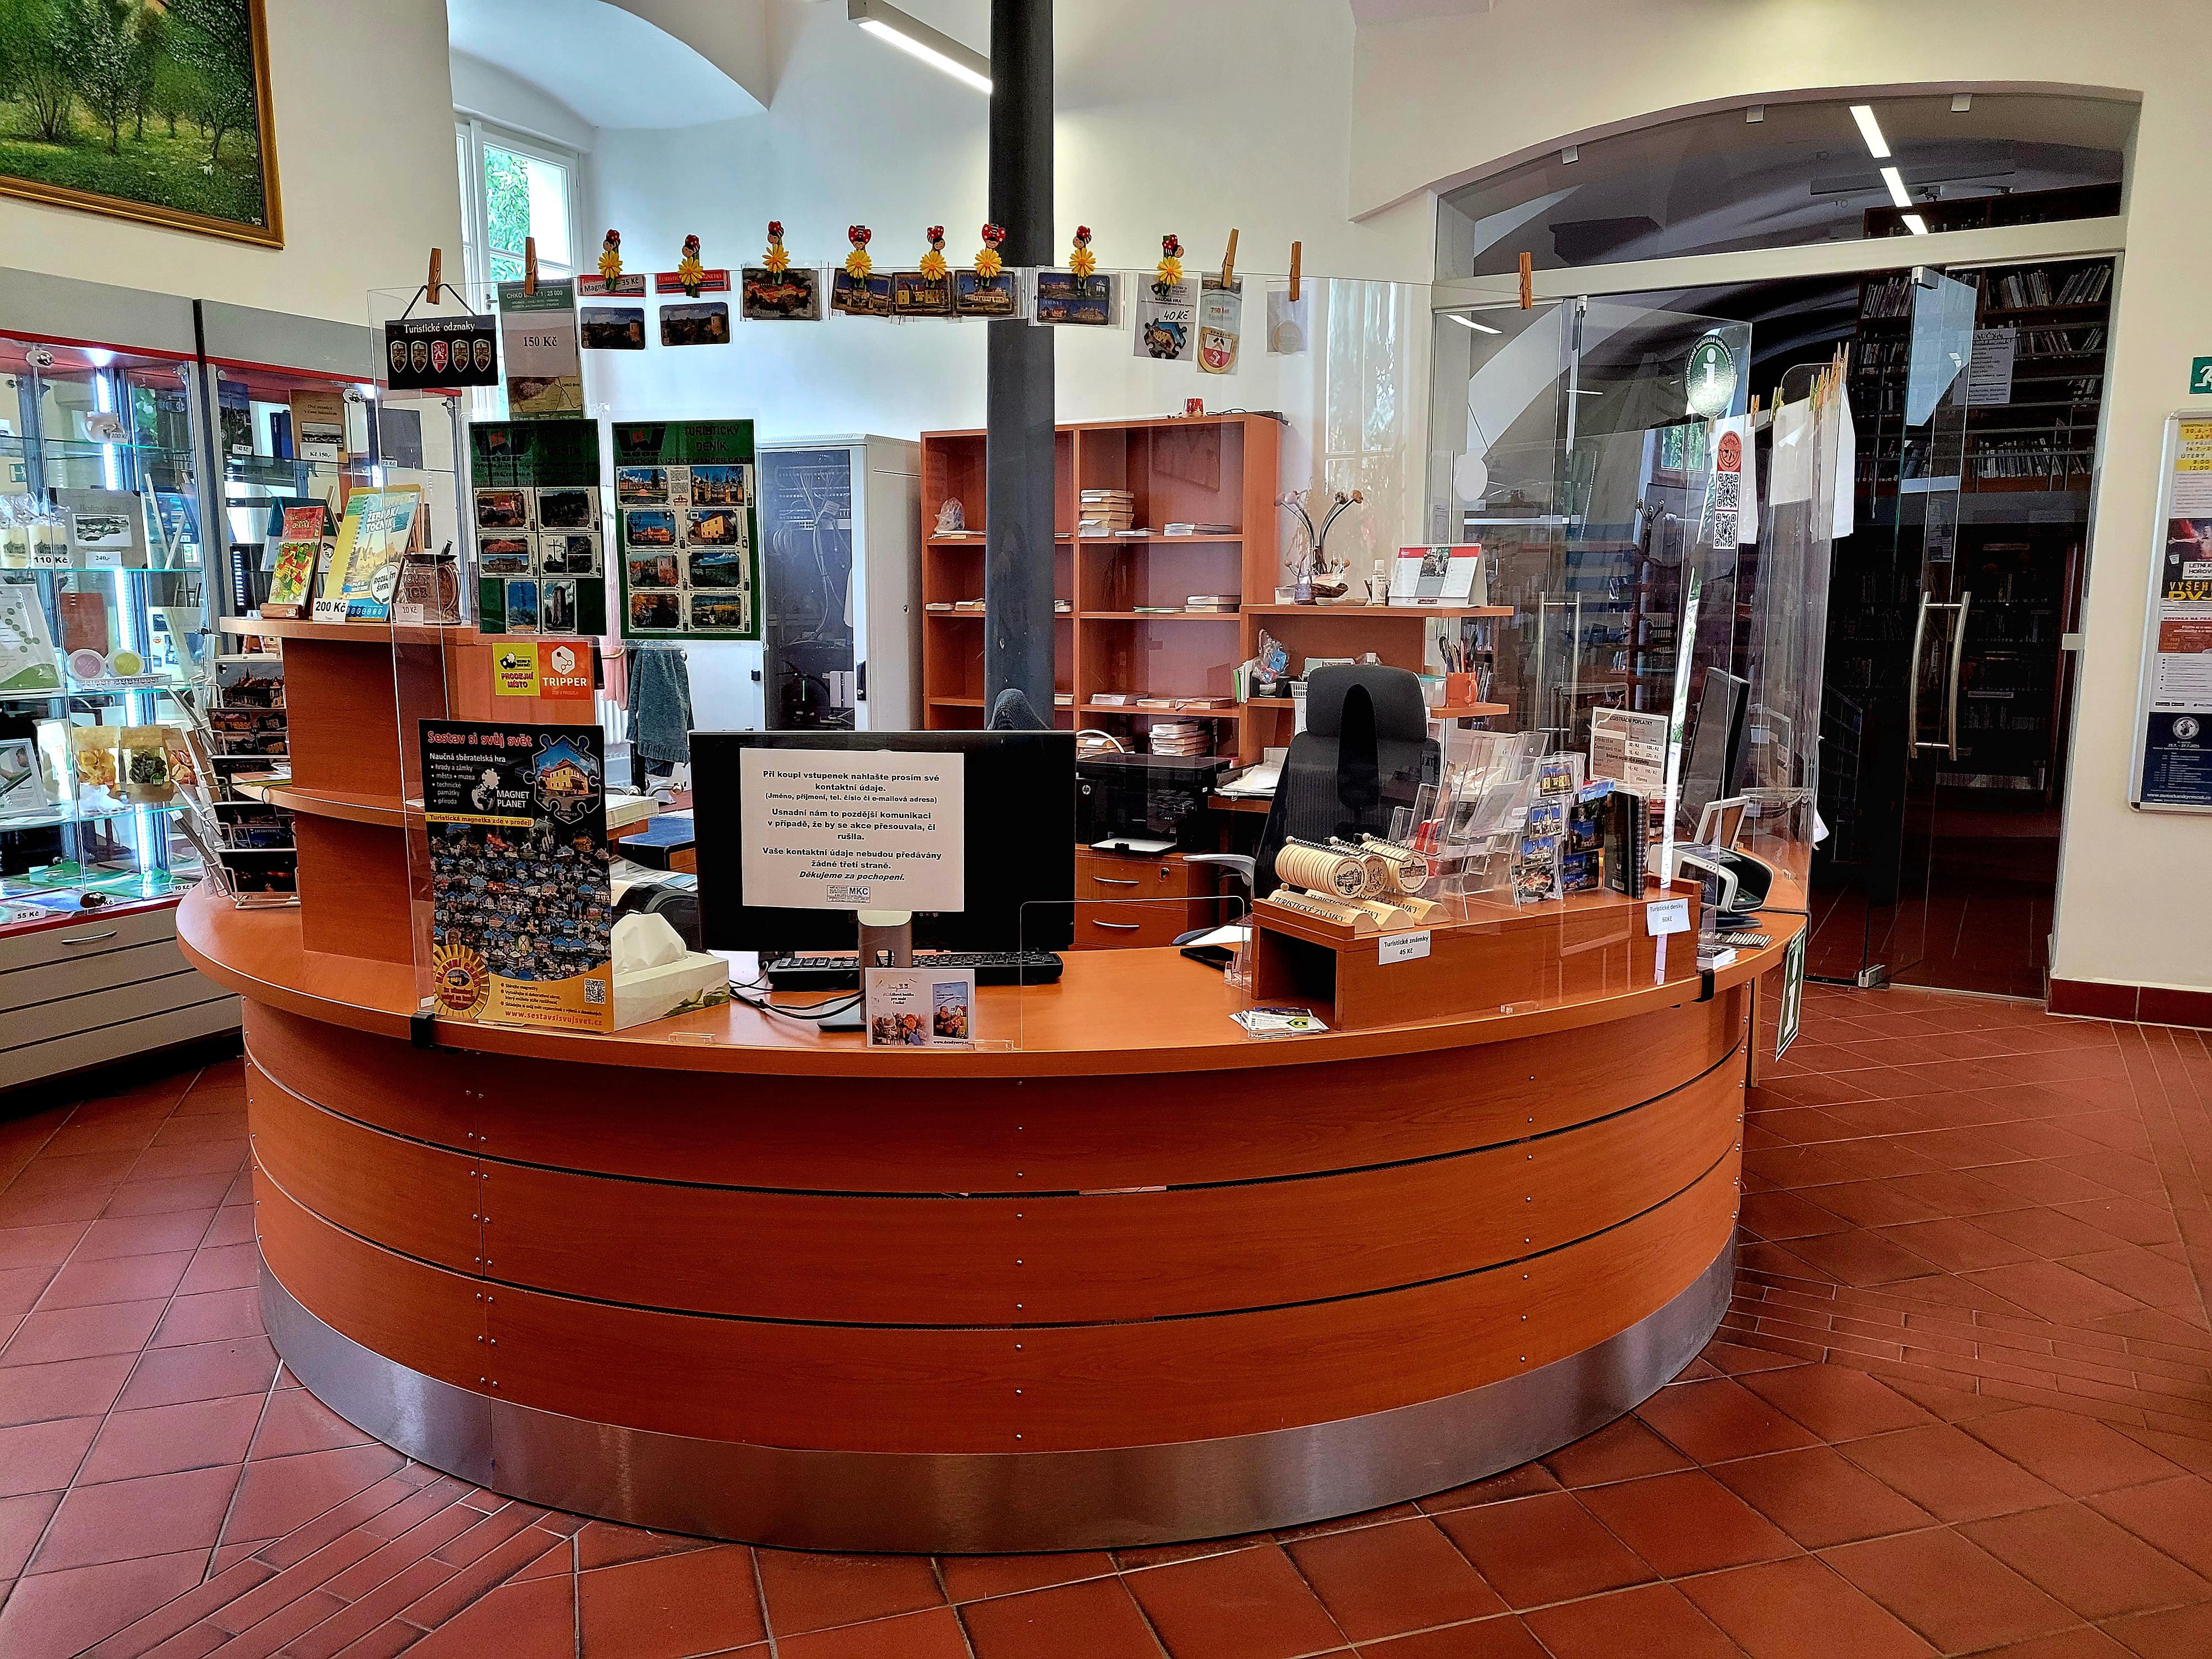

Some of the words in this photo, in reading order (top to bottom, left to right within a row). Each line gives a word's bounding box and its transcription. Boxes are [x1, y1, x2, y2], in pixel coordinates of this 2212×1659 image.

[585, 283, 608, 293] Magne
[631, 276, 639, 285] Kč
[1164, 310, 1176, 320] 40
[1176, 310, 1190, 320] Kč
[404, 322, 440, 333] Turistické
[444, 320, 476, 331] odznaky
[523, 336, 540, 347] 150
[542, 336, 557, 347] Kč
[695, 440, 727, 451] DENÍK
[315, 601, 329, 612] 200
[333, 602, 347, 613] Kč
[501, 671, 534, 680] PRODEJNÍ
[507, 680, 528, 688] MÍSTO
[542, 677, 587, 687] TRIPPER
[427, 731, 465, 744] Sestav
[468, 733, 478, 744] si
[481, 732, 505, 748] svůj
[508, 734, 533, 747] svět
[456, 754, 493, 762] sběratelská
[456, 764, 473, 773] zámky
[777, 771, 801, 780] koupi
[891, 774, 921, 782] prosím
[815, 783, 857, 791] kontaktní
[859, 784, 886, 793] údaje.
[497, 790, 530, 799] MAGNET
[765, 792, 795, 801] (Jméno,
[796, 793, 828, 802] příjmení,
[497, 800, 526, 808] PLANET
[772, 808, 807, 816] Usnadní
[842, 810, 878, 819] pozdější
[510, 818, 532, 827] prodeji
[775, 820, 810, 829] případě,
[825, 821, 836, 830] by
[874, 823, 925, 832] přesouvala,
[786, 848, 828, 856] kontaktní
[830, 849, 854, 858] údaje
[896, 851, 942, 860] předávány
[799, 871, 843, 880] Děkujeme
[857, 873, 905, 881] pochopení.
[849, 887, 869, 895] MKC
[1273, 896, 1314, 913] TURISTICKÉ
[1313, 907, 1347, 922] ZNÁMKY
[1384, 938, 1408, 948] Turistické
[1408, 935, 1429, 945] známky
[505, 1010, 603, 1026] www.sestavsisvujsvet.cz
